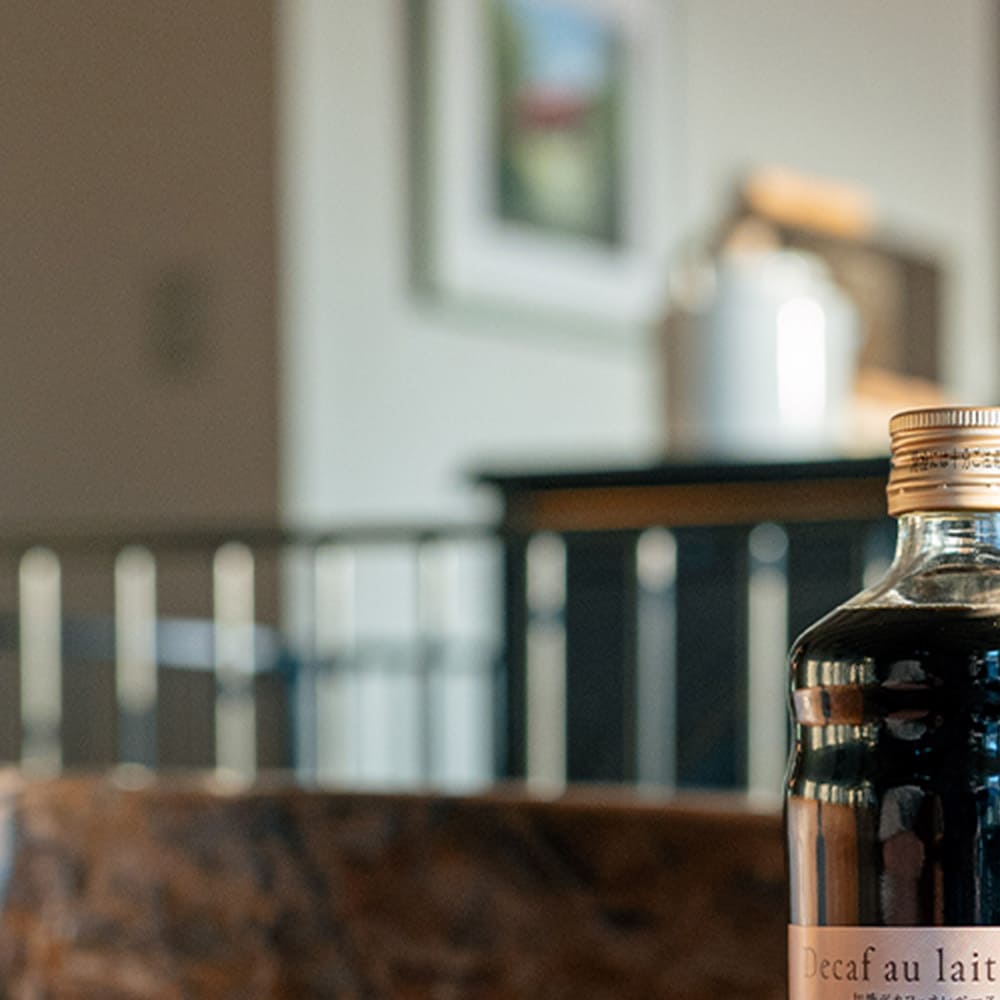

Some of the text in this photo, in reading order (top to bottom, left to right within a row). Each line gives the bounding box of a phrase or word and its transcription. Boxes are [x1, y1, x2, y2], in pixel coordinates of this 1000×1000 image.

[803, 946, 876, 982] Decaf
[883, 957, 921, 982] au
[935, 947, 997, 982] lait
